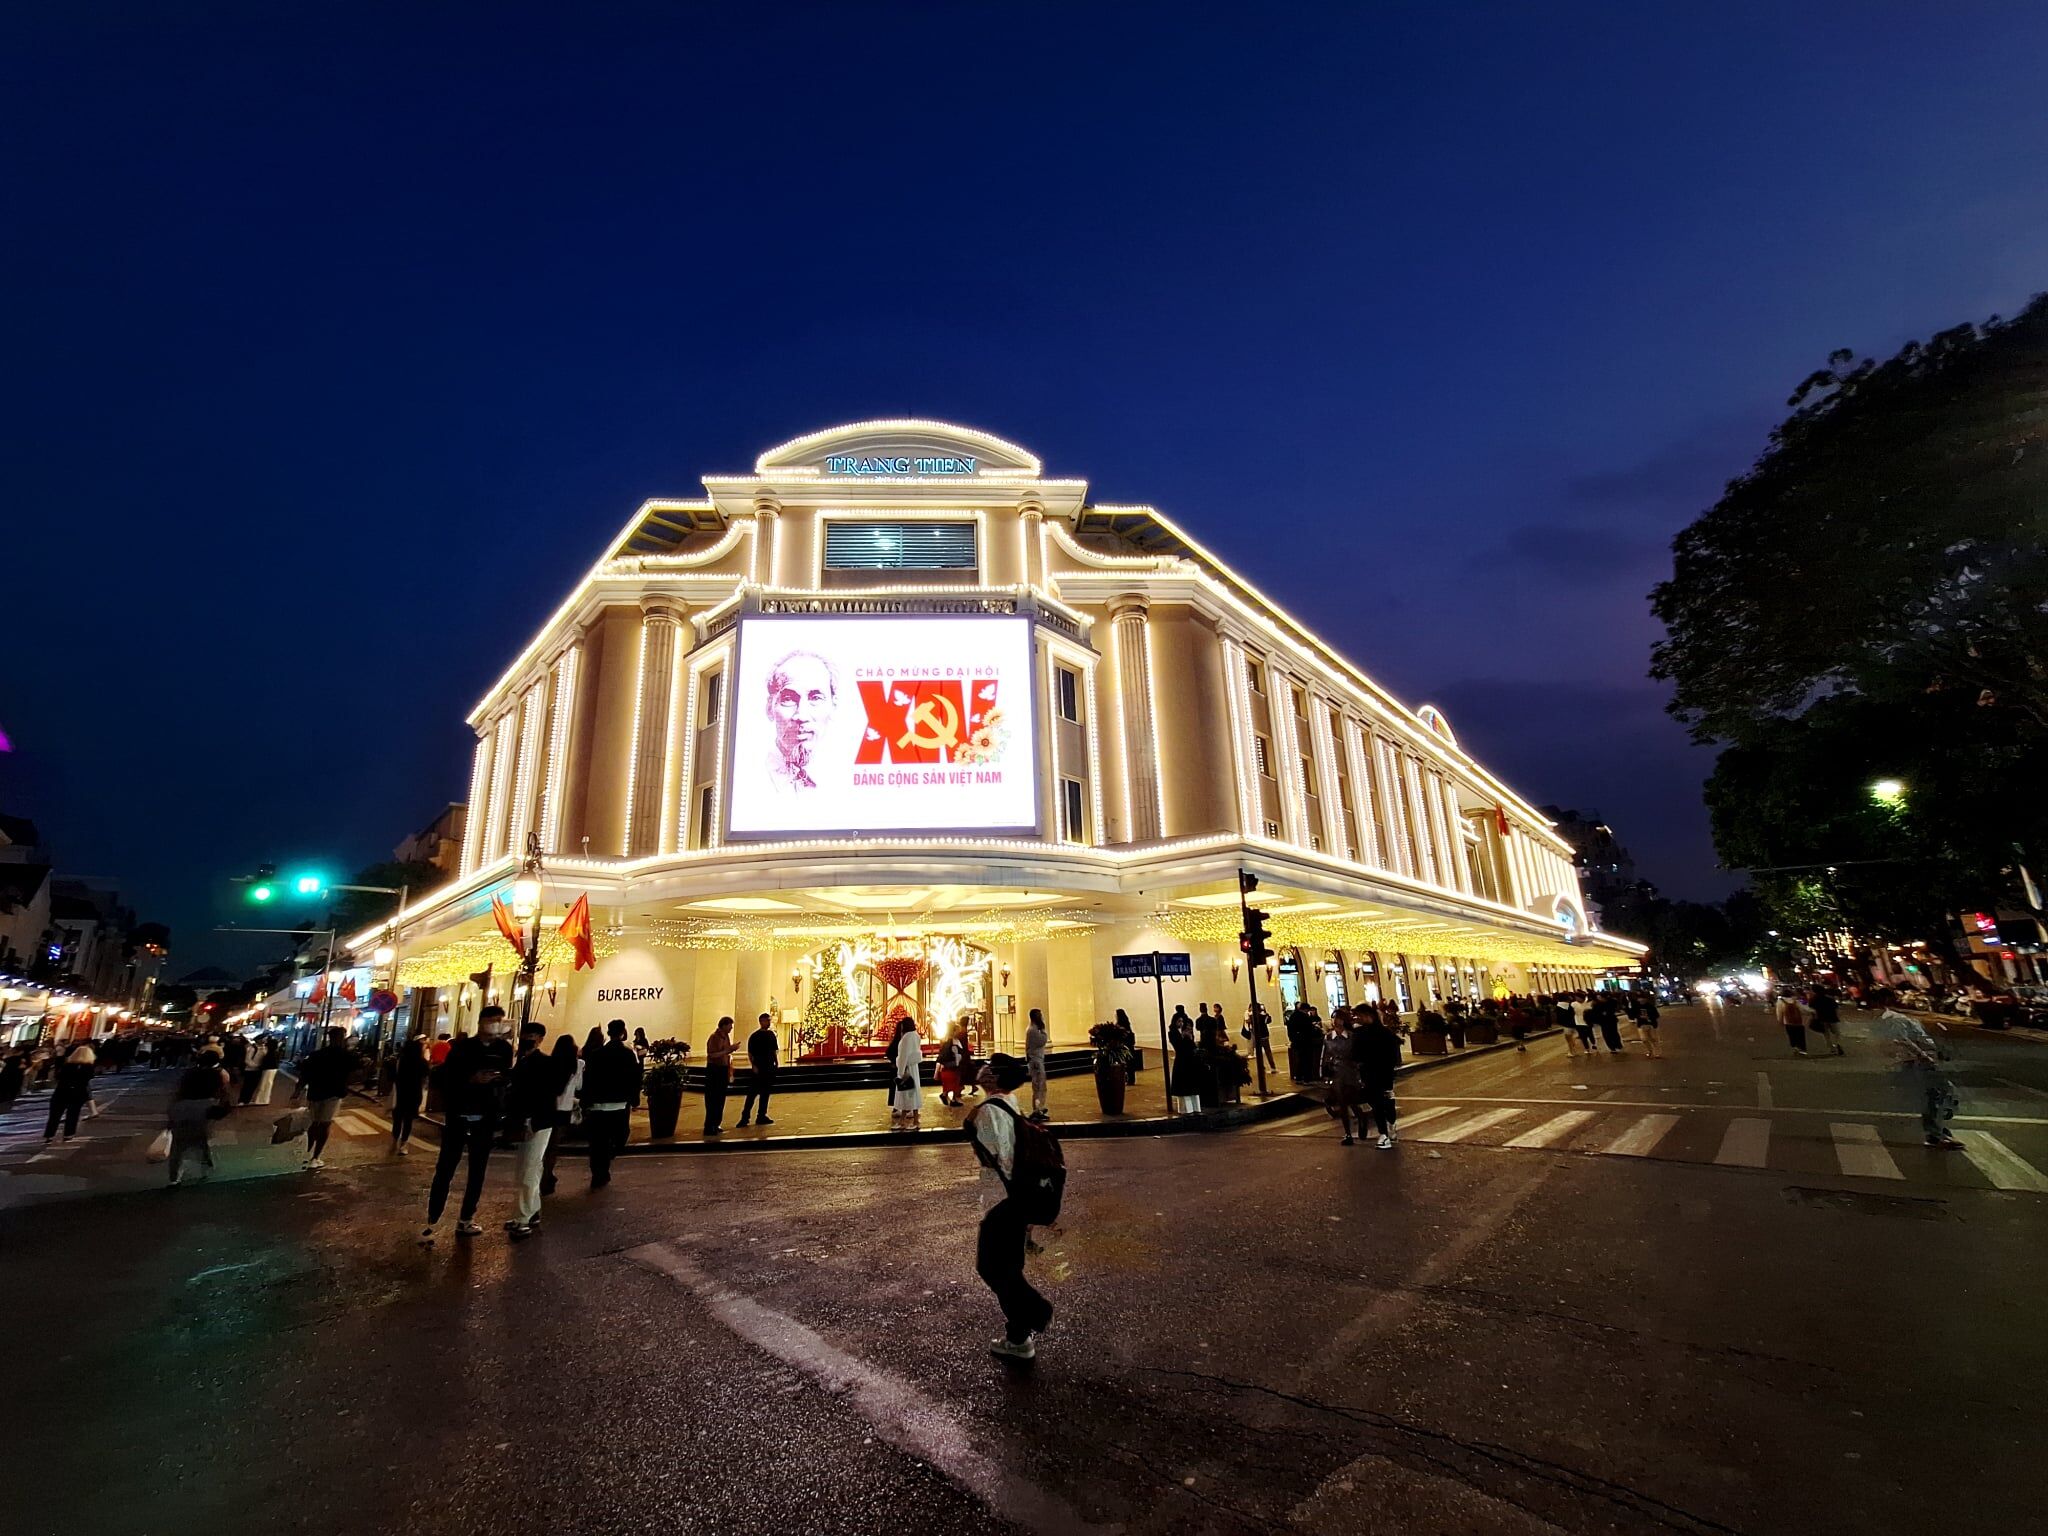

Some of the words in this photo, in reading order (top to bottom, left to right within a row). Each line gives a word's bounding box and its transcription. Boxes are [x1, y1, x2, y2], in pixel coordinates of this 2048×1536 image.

[825, 456, 910, 475] TRANG
[914, 457, 976, 474] TIEN
[888, 770, 919, 787] CỘNG
[922, 769, 945, 785] SẢN
[949, 769, 973, 787] VIỆT
[975, 771, 1002, 784] NAM
[598, 987, 664, 1001] BURBERRY
